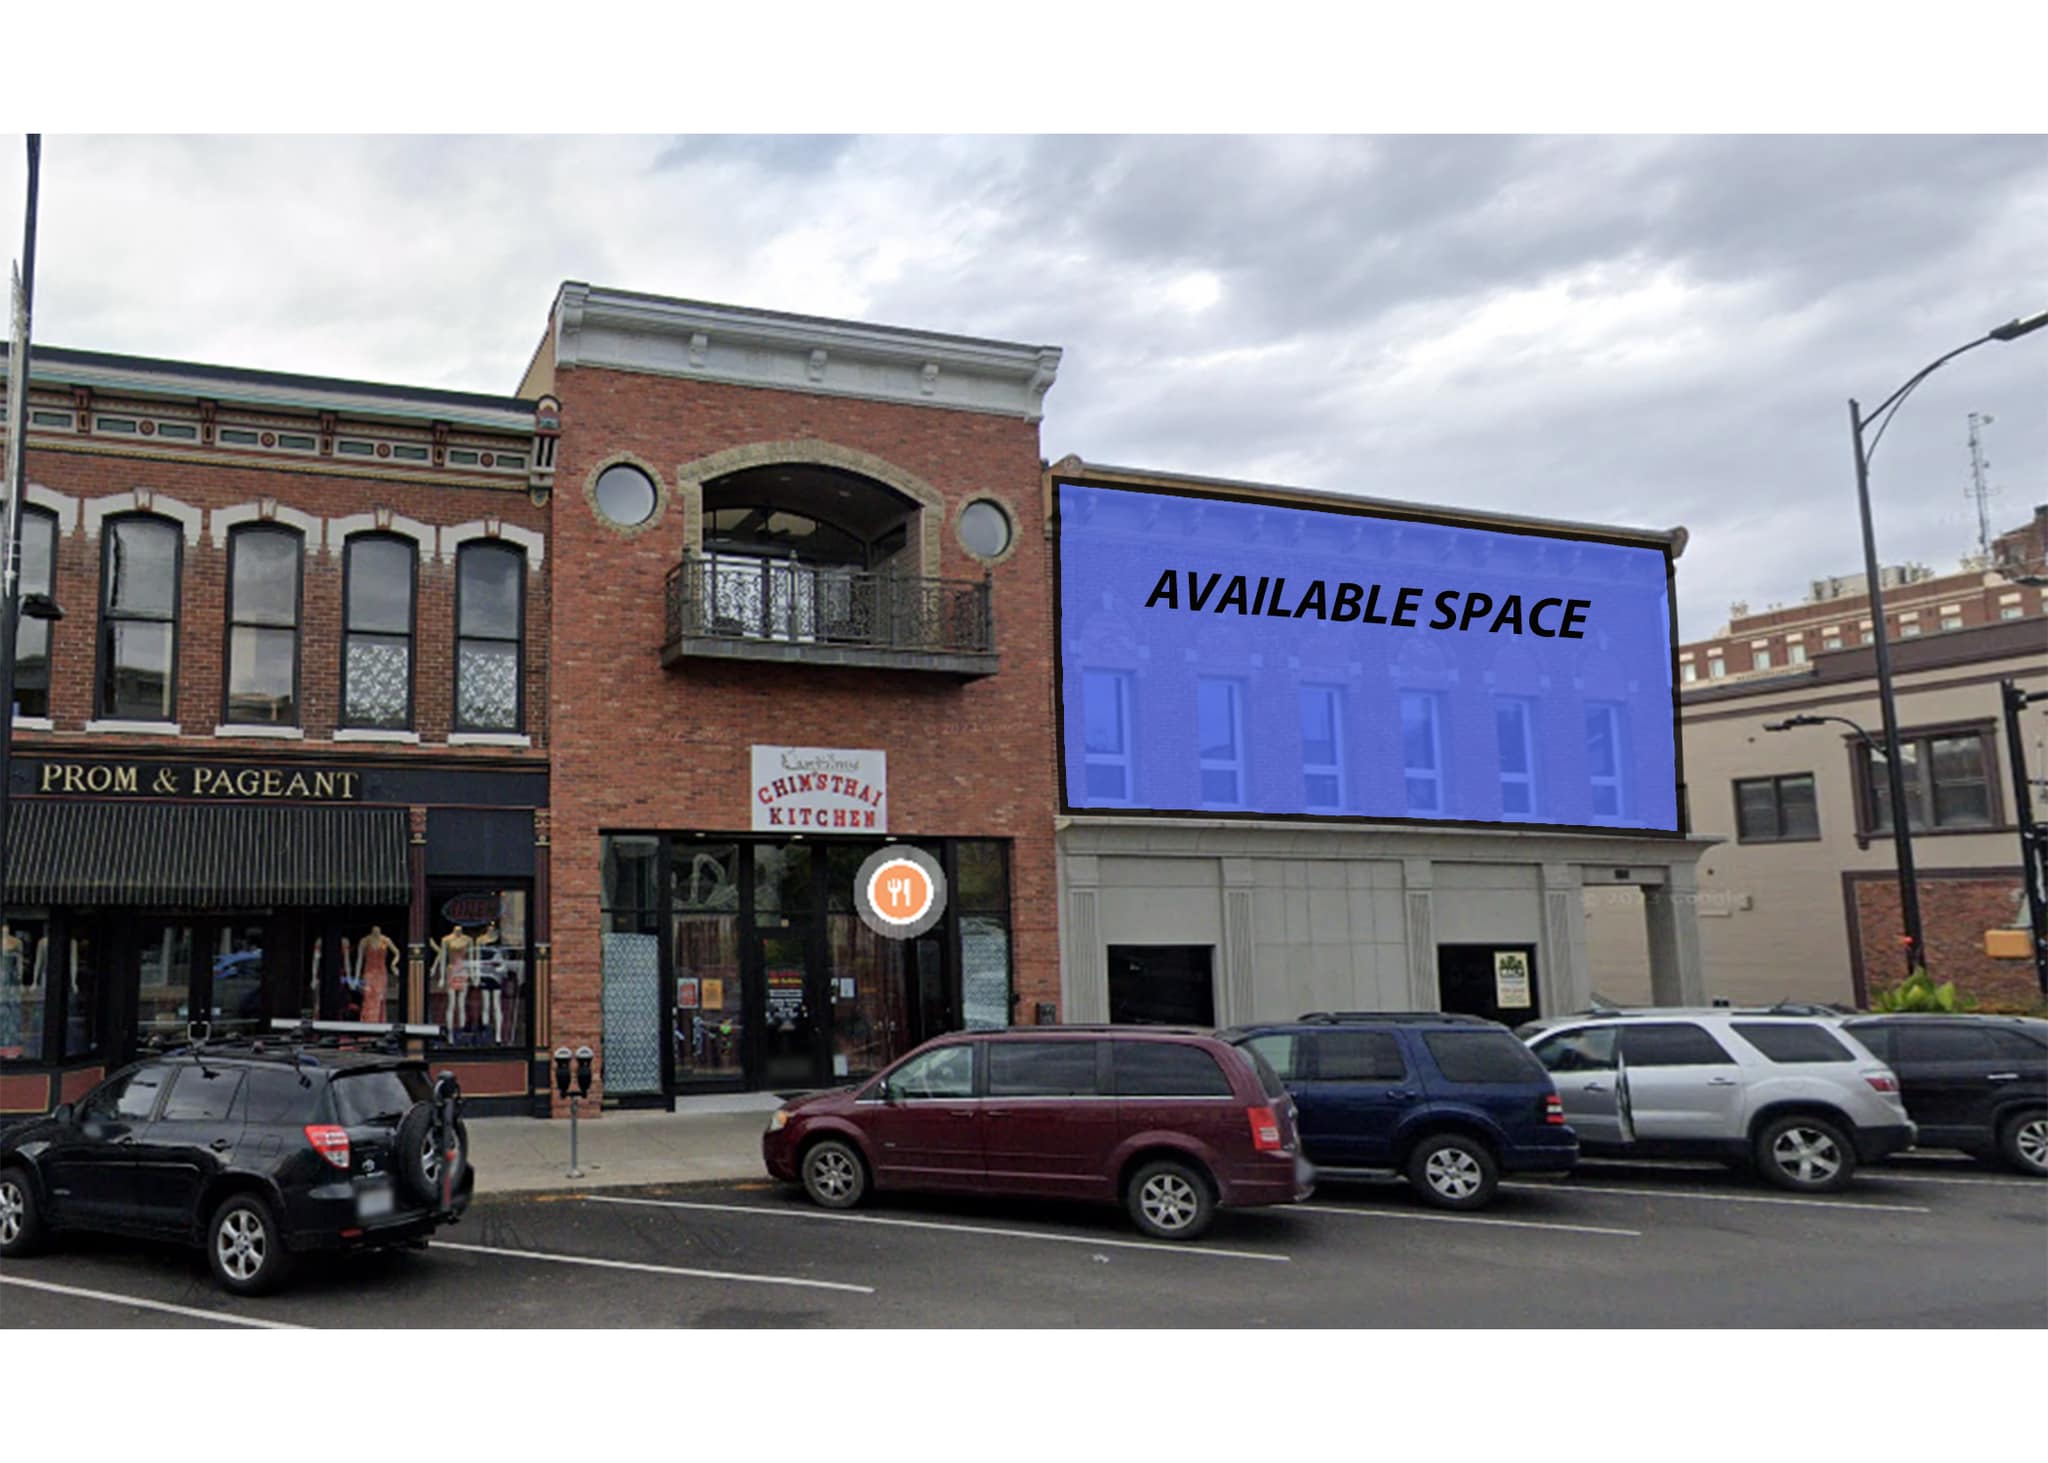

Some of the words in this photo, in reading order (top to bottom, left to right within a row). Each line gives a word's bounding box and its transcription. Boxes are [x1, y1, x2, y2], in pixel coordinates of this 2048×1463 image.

[41, 763, 138, 793] PROM
[152, 767, 179, 794] &
[192, 767, 359, 799] PAGEANT
[769, 807, 876, 828] KITCHEN
